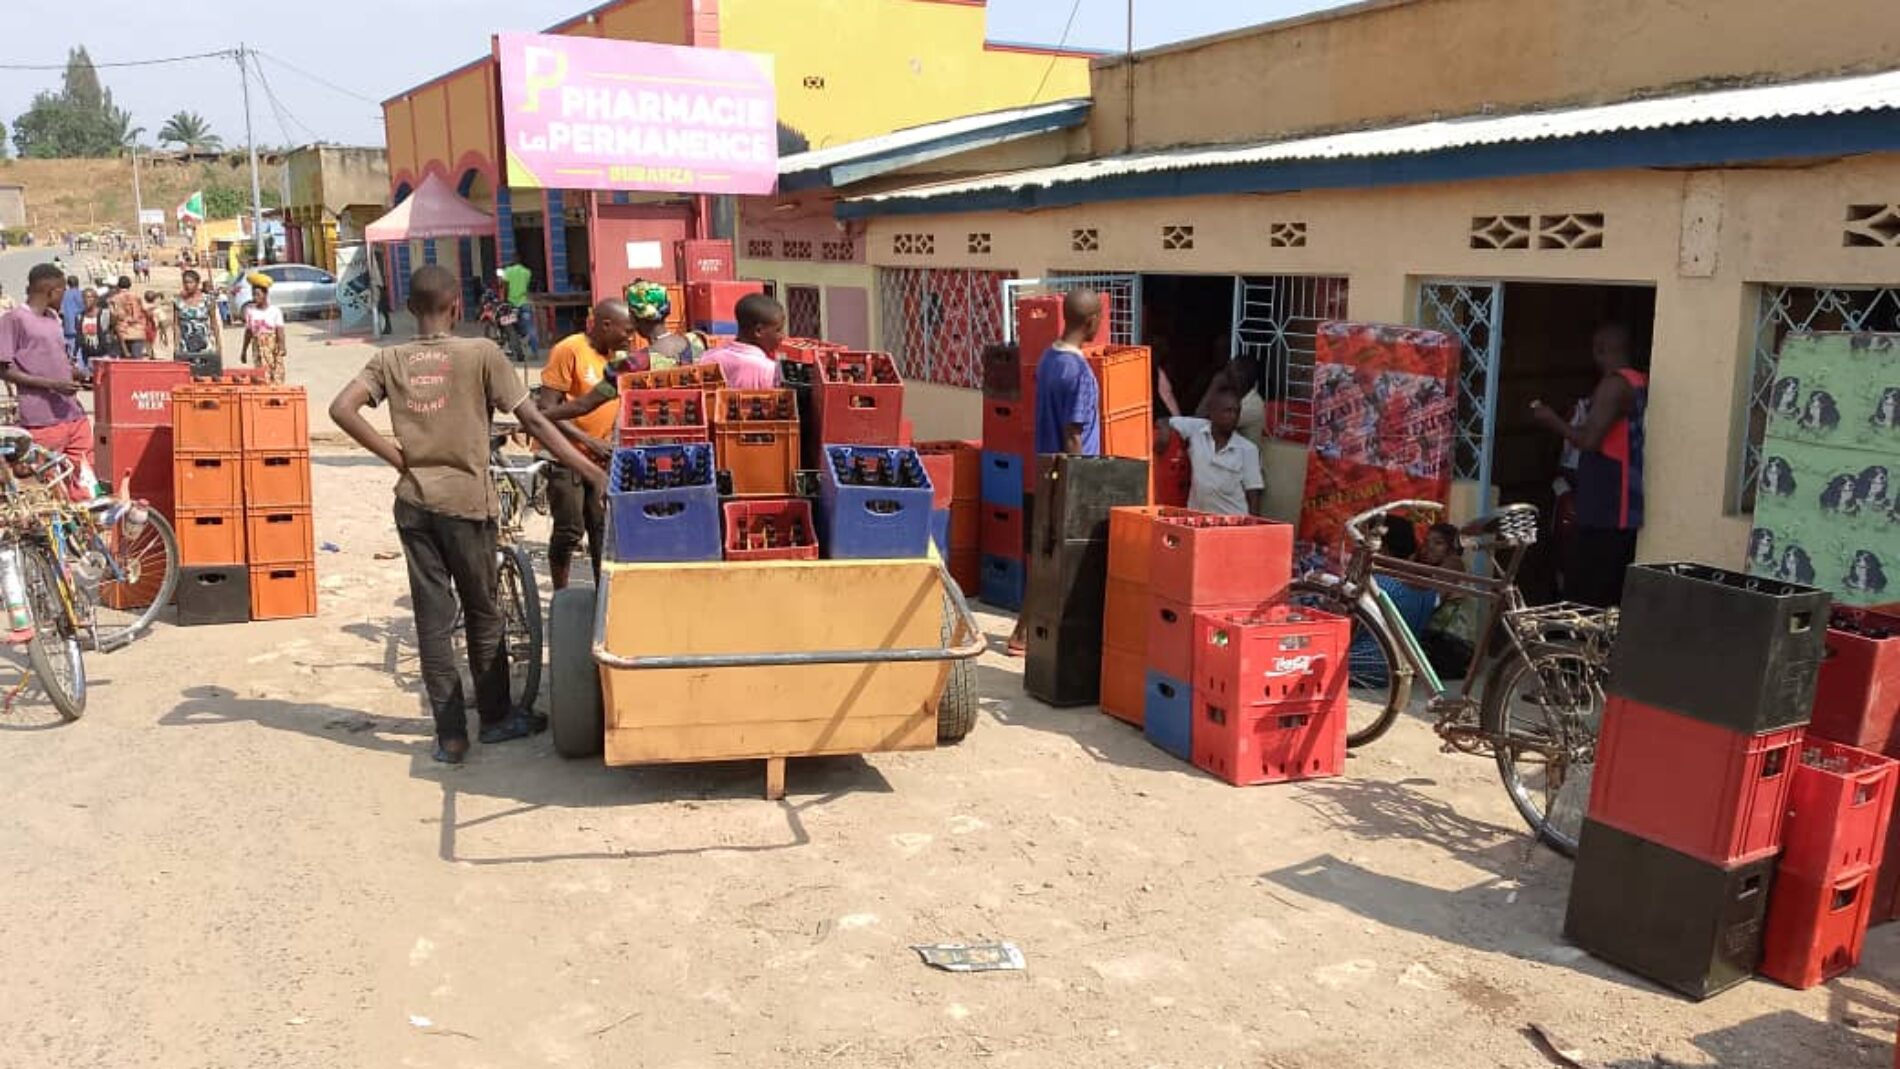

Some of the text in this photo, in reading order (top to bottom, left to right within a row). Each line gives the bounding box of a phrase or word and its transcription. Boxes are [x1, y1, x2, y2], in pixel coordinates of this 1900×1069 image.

[561, 85, 766, 128] PHARMACIE
[518, 121, 767, 161] La PERMANENCE
[131, 390, 172, 401] AMSTEL
